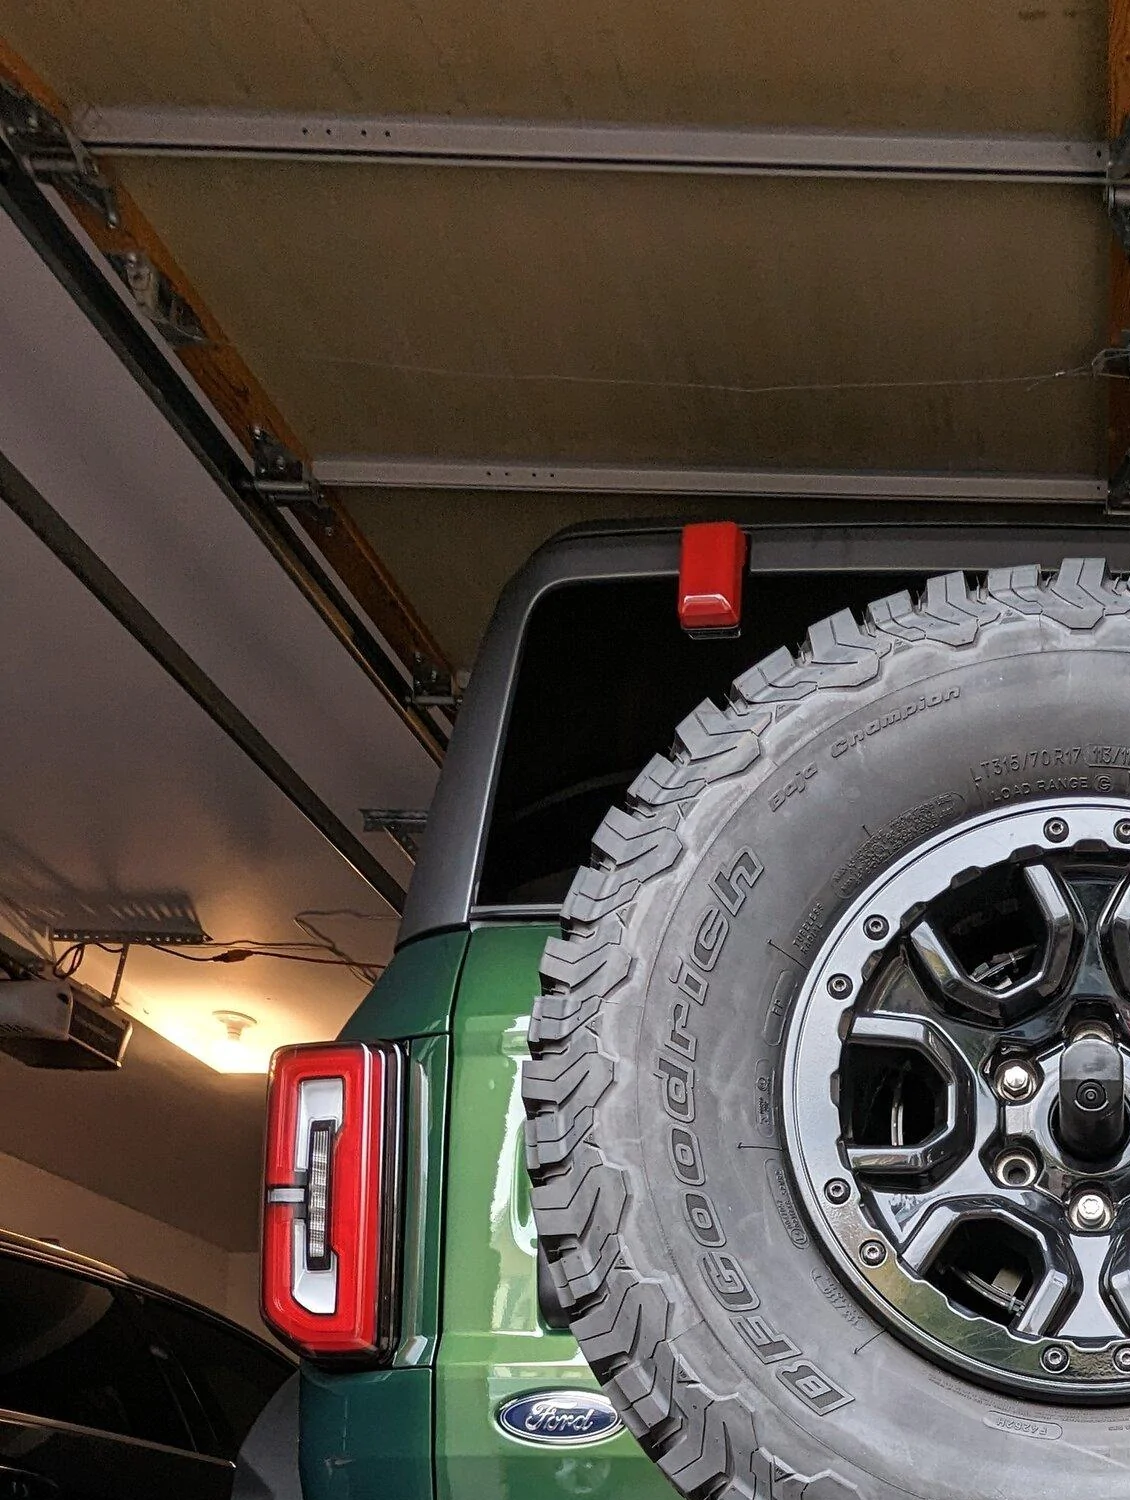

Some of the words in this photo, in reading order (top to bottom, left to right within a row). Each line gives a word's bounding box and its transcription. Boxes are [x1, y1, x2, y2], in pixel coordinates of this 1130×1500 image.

[767, 760, 818, 813] Baja
[830, 685, 962, 759] Champion
[970, 746, 1083, 787] LT315/70R17
[991, 780, 1031, 802] LOAD
[1034, 776, 1089, 792] RANGE
[653, 843, 857, 1417] BFGoodrich
[524, 1398, 595, 1432] Ford
